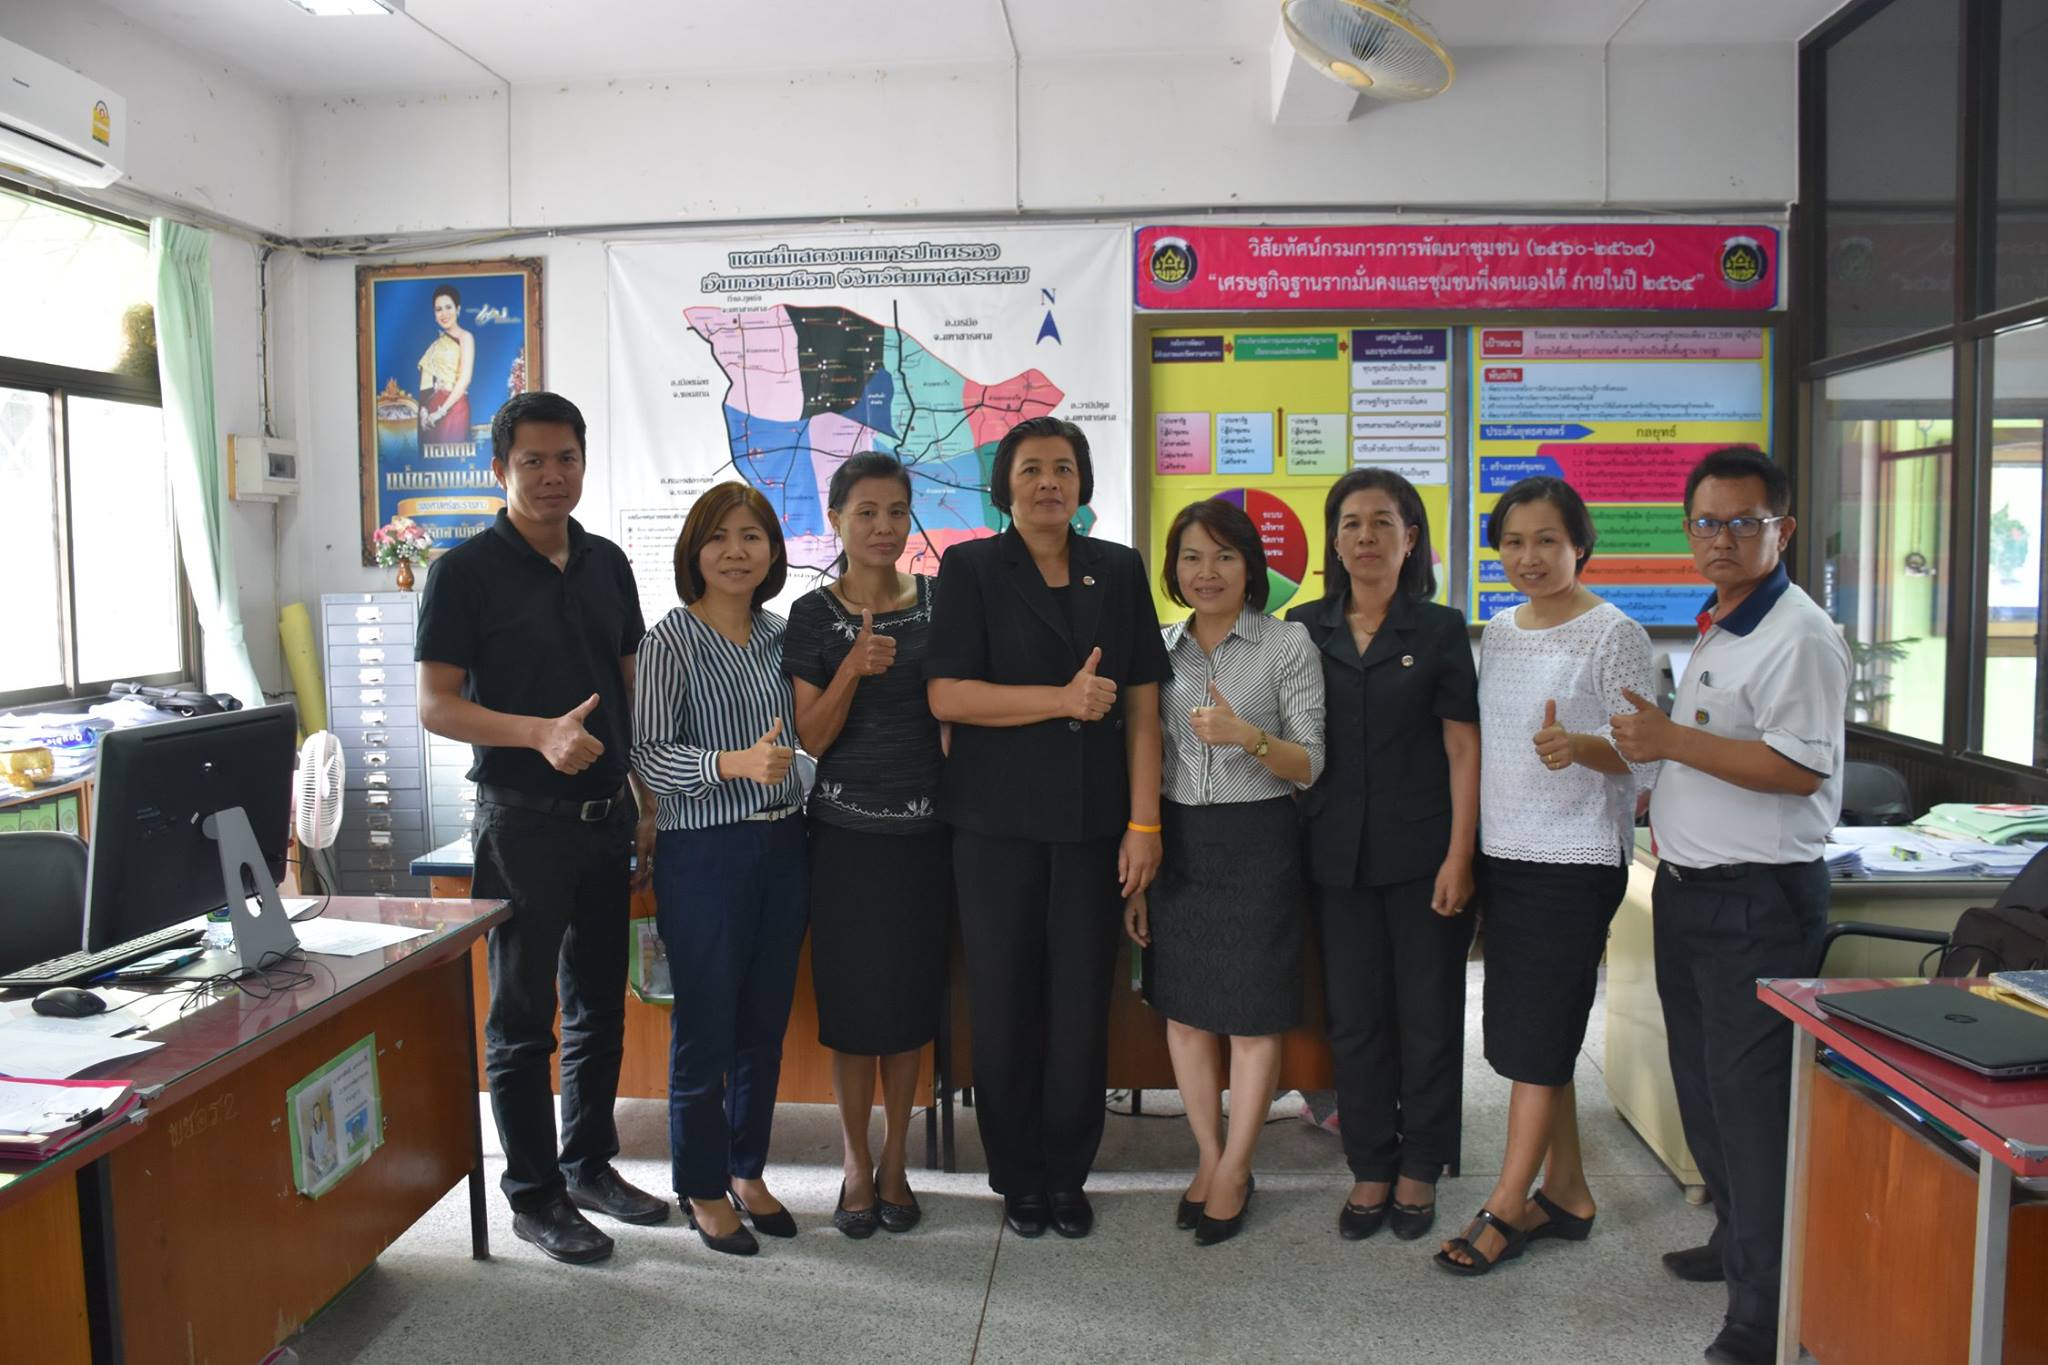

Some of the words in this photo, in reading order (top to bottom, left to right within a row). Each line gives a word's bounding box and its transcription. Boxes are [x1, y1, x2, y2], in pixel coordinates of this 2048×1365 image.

[729, 242, 1001, 268] แผนที่แสดงเขตการปกครอง
[1248, 236, 1520, 262] วิสัยทัศน์กรมการการพัฒนาชุมชน
[1526, 239, 1656, 258] (๒๕๖๐-๒๕๖๔)
[701, 270, 836, 293] อำเภอนาเชือก
[837, 266, 1031, 288] จังหวัดมหาสารคาม
[1572, 266, 1636, 291] ภายในปี
[1040, 288, 1056, 305] N
[1636, 425, 1677, 440] กลยุทธ์
[423, 442, 477, 463] กองทุน
